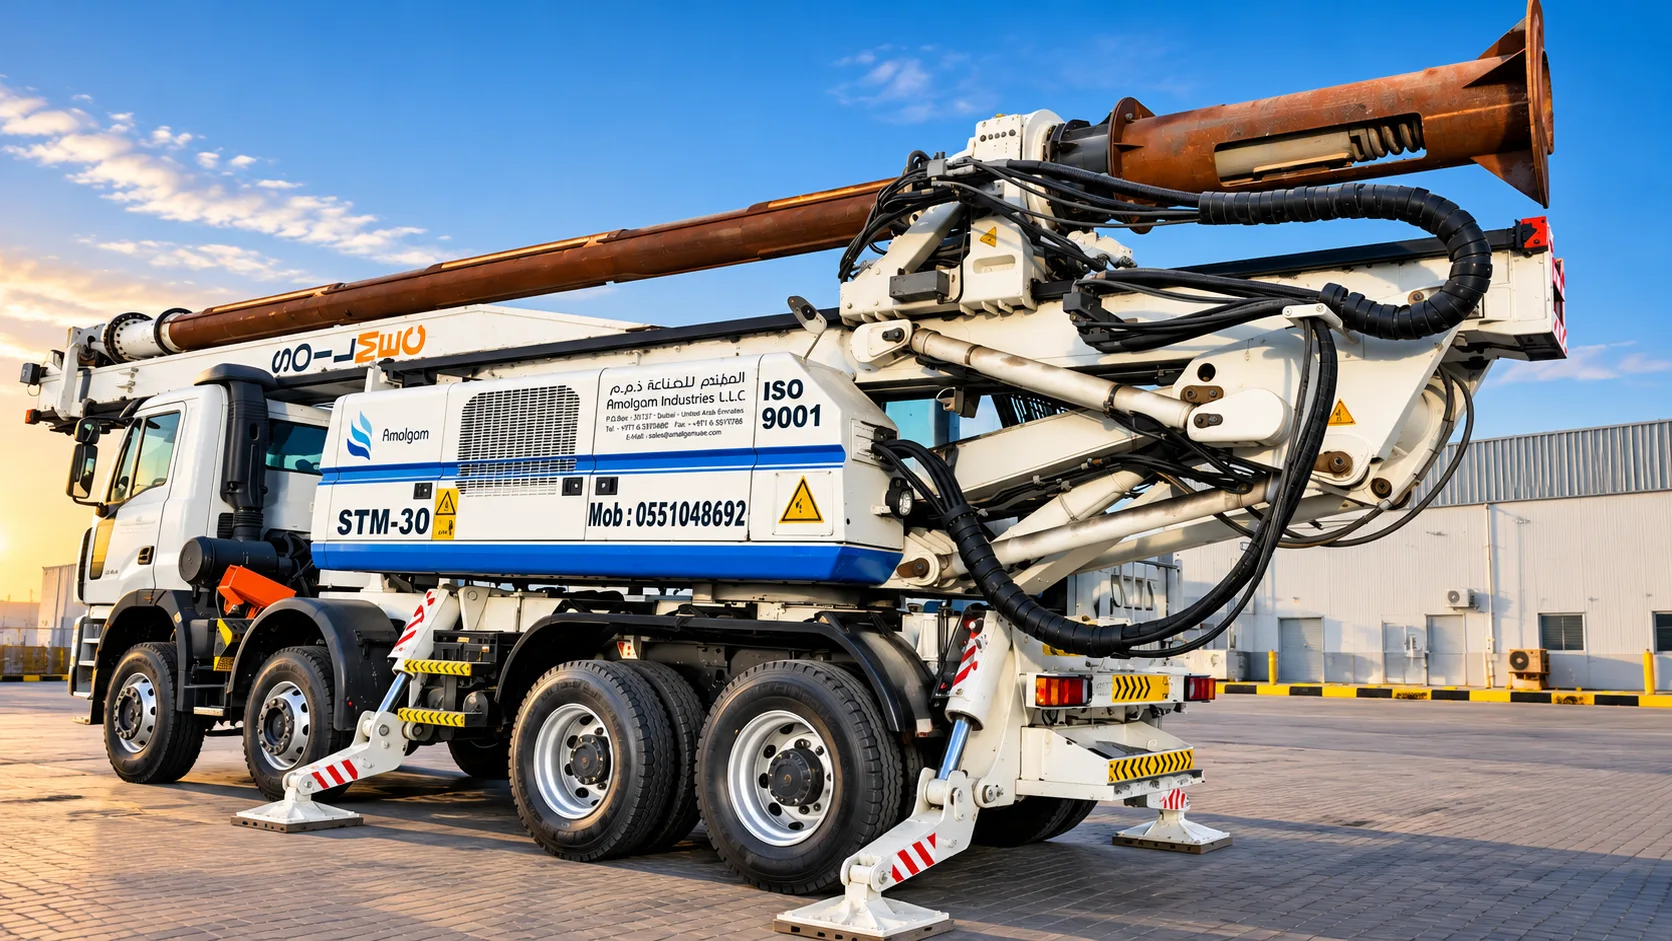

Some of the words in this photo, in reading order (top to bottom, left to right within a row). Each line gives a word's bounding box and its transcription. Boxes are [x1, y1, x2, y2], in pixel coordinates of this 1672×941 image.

[272, 325, 426, 373] SOILMEC
[662, 394, 714, 406] Industries
[764, 379, 804, 401] ISO
[762, 404, 820, 429] 9001
[337, 508, 430, 535] STM-30
[636, 500, 746, 527] 0551048692
